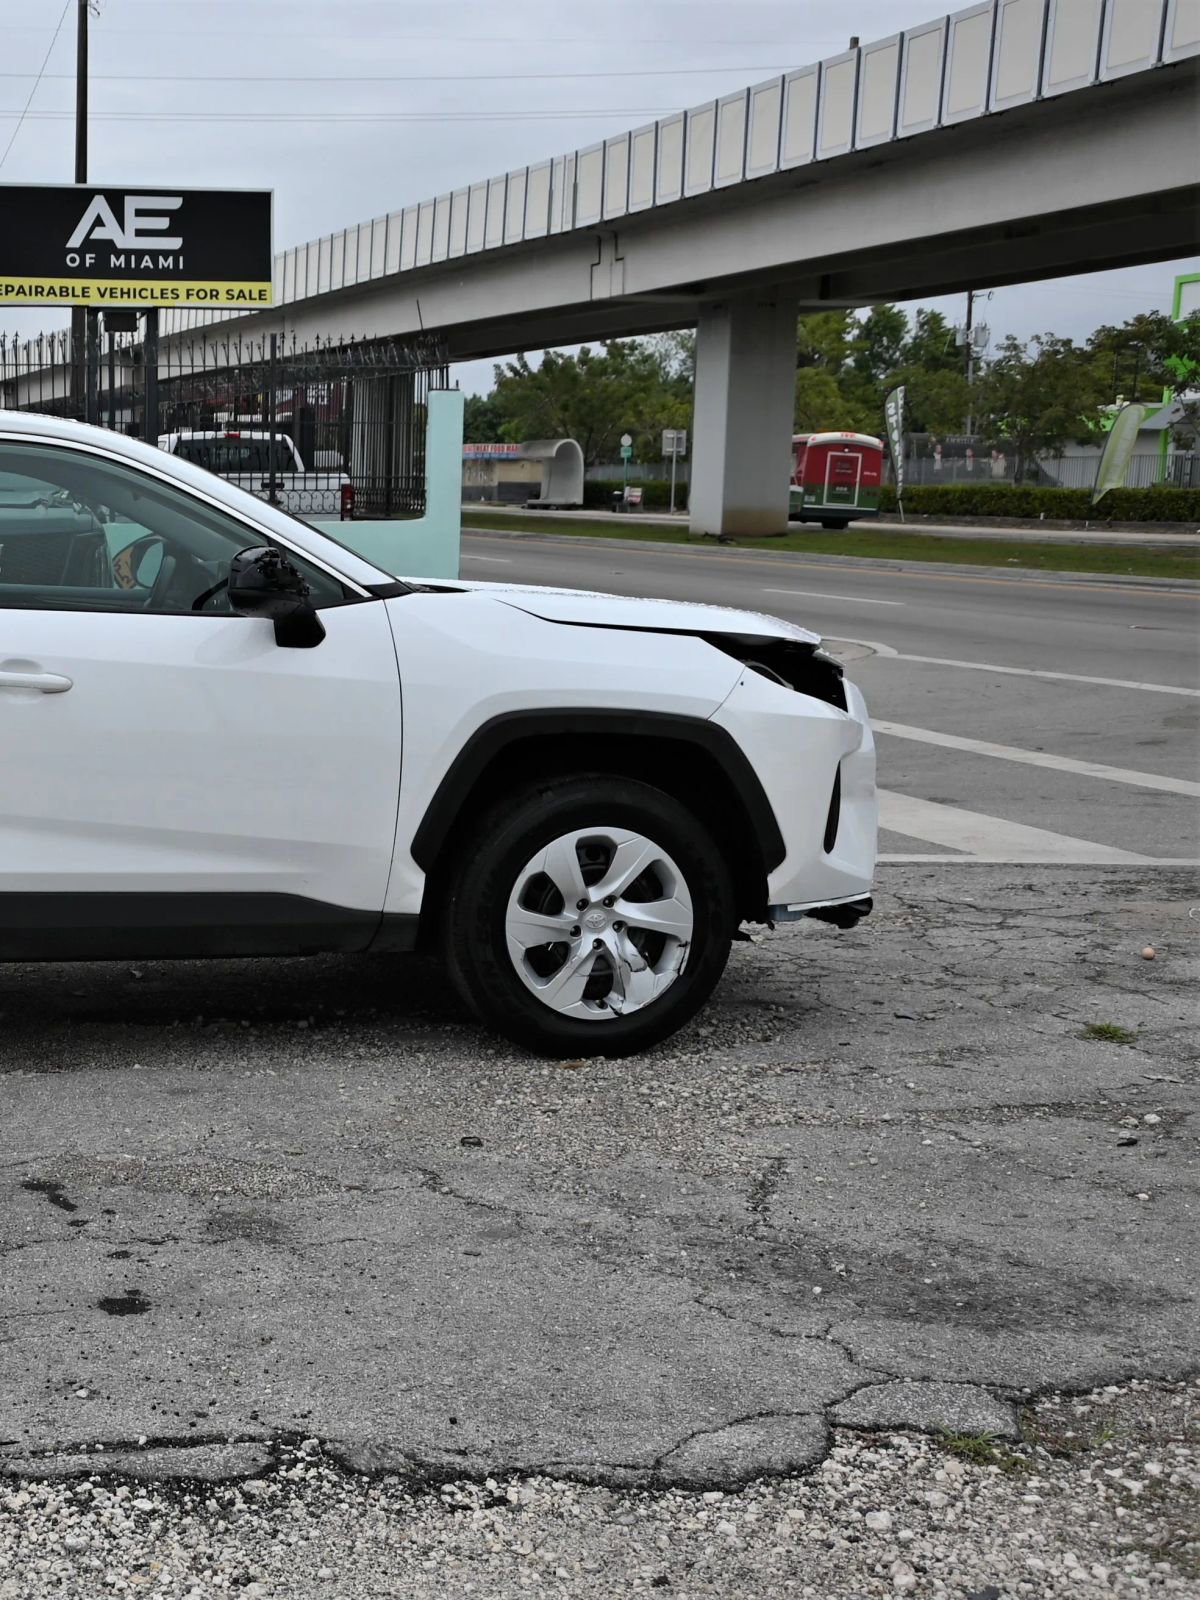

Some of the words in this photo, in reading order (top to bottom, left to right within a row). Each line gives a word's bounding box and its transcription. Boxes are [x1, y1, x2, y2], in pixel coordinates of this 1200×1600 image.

[64, 194, 184, 250] AE
[65, 253, 96, 268] OF
[110, 254, 184, 270] MIAMI
[96, 286, 180, 301] VEHICLES
[186, 288, 220, 301] FOR
[225, 288, 268, 302] SALE
